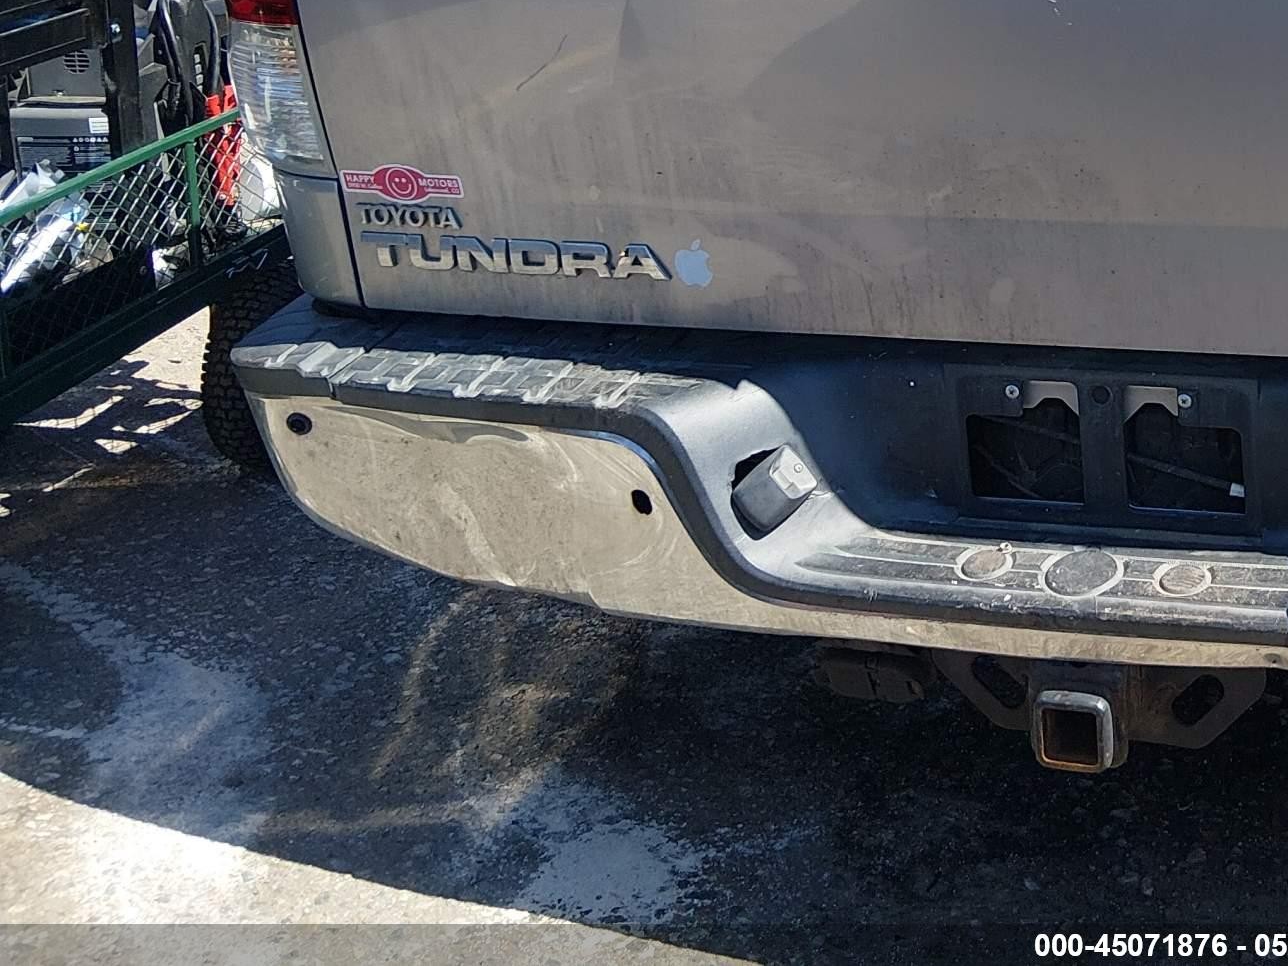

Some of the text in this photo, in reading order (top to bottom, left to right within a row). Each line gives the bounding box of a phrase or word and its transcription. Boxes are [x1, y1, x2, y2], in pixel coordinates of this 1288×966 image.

[345, 174, 459, 188] HAPPY MOTORS
[356, 202, 463, 231] TOYOTA
[360, 231, 672, 281] TUNDRA
